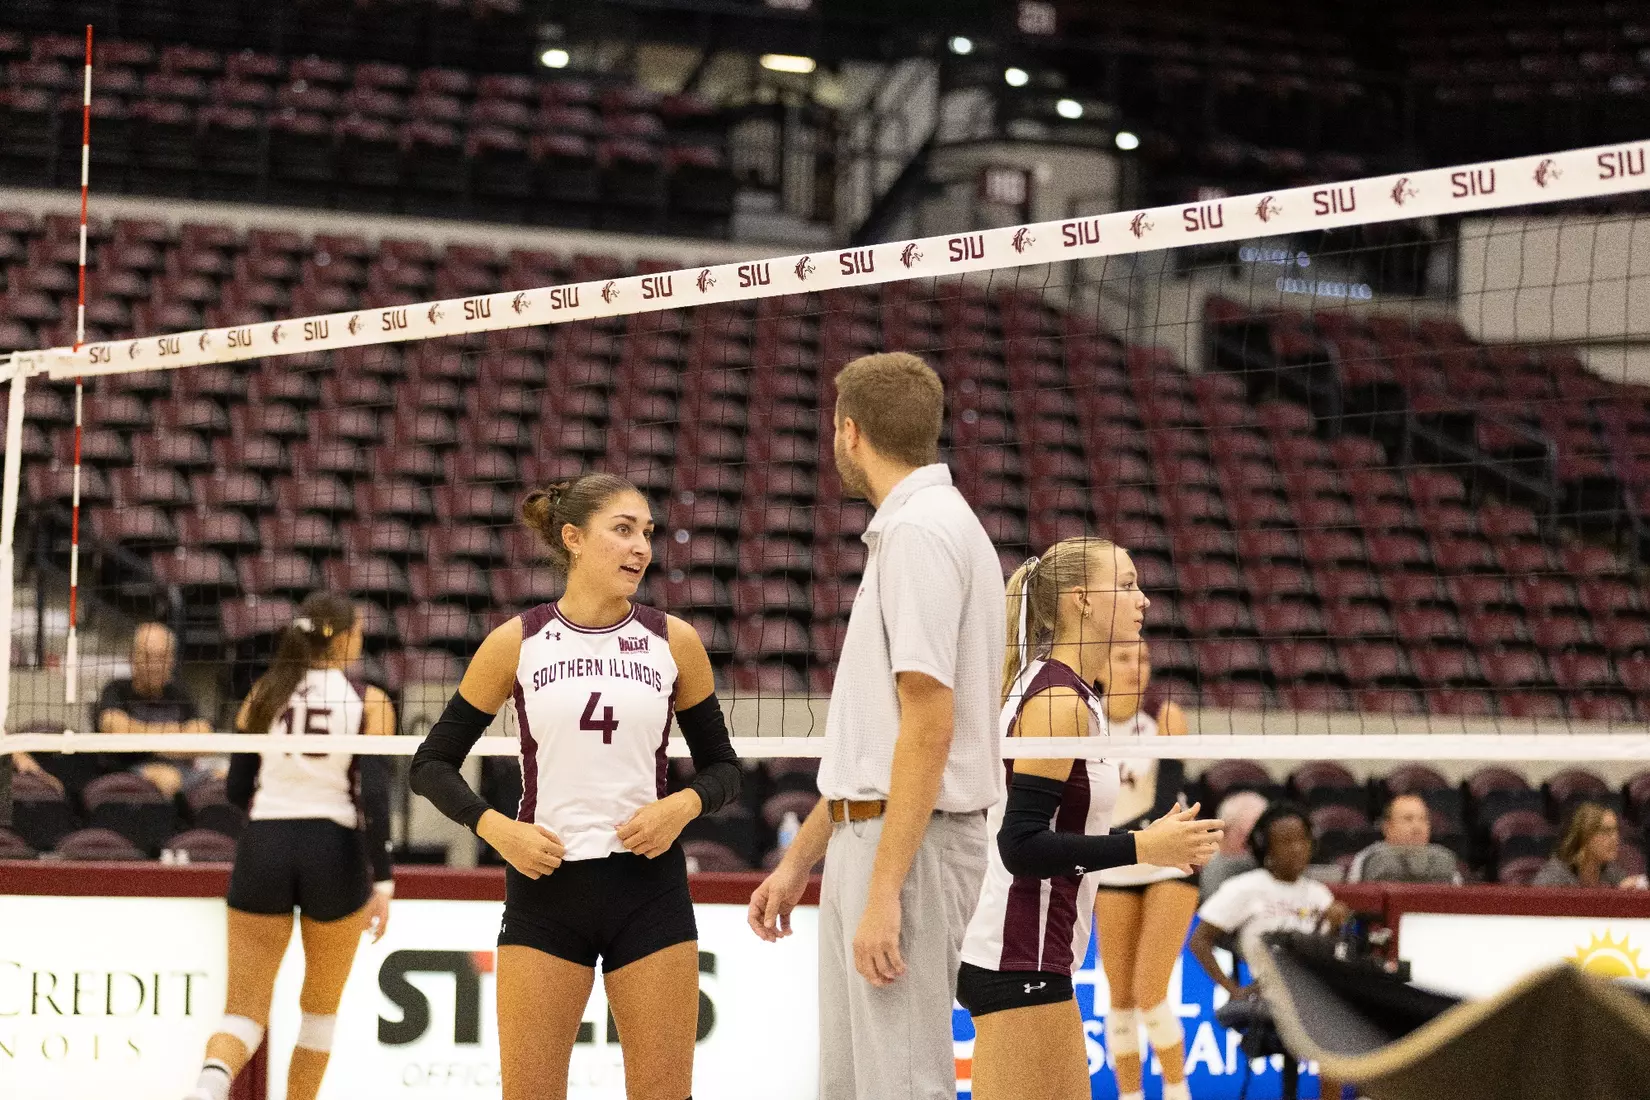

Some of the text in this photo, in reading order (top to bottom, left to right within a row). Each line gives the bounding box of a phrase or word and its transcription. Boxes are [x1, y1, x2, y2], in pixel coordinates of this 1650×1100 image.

[158, 338, 180, 357] SIU
[227, 329, 252, 348] SIU
[303, 319, 329, 342] SIU
[381, 309, 408, 332] SIU
[463, 297, 491, 321] SIU
[550, 286, 580, 310] SIU
[641, 275, 673, 300] SIU
[737, 262, 771, 288] SIU
[839, 249, 875, 276] SIU
[948, 234, 985, 263] SIU
[1061, 219, 1100, 248] SIU
[1182, 203, 1224, 233] SIU
[1312, 186, 1356, 216] SIU
[1451, 167, 1496, 199] SIU
[1597, 148, 1646, 181] SIU
[618, 635, 649, 651] VALLEY
[533, 658, 662, 692] SOUTHERN ILLINOIS
[579, 691, 620, 745] 4
